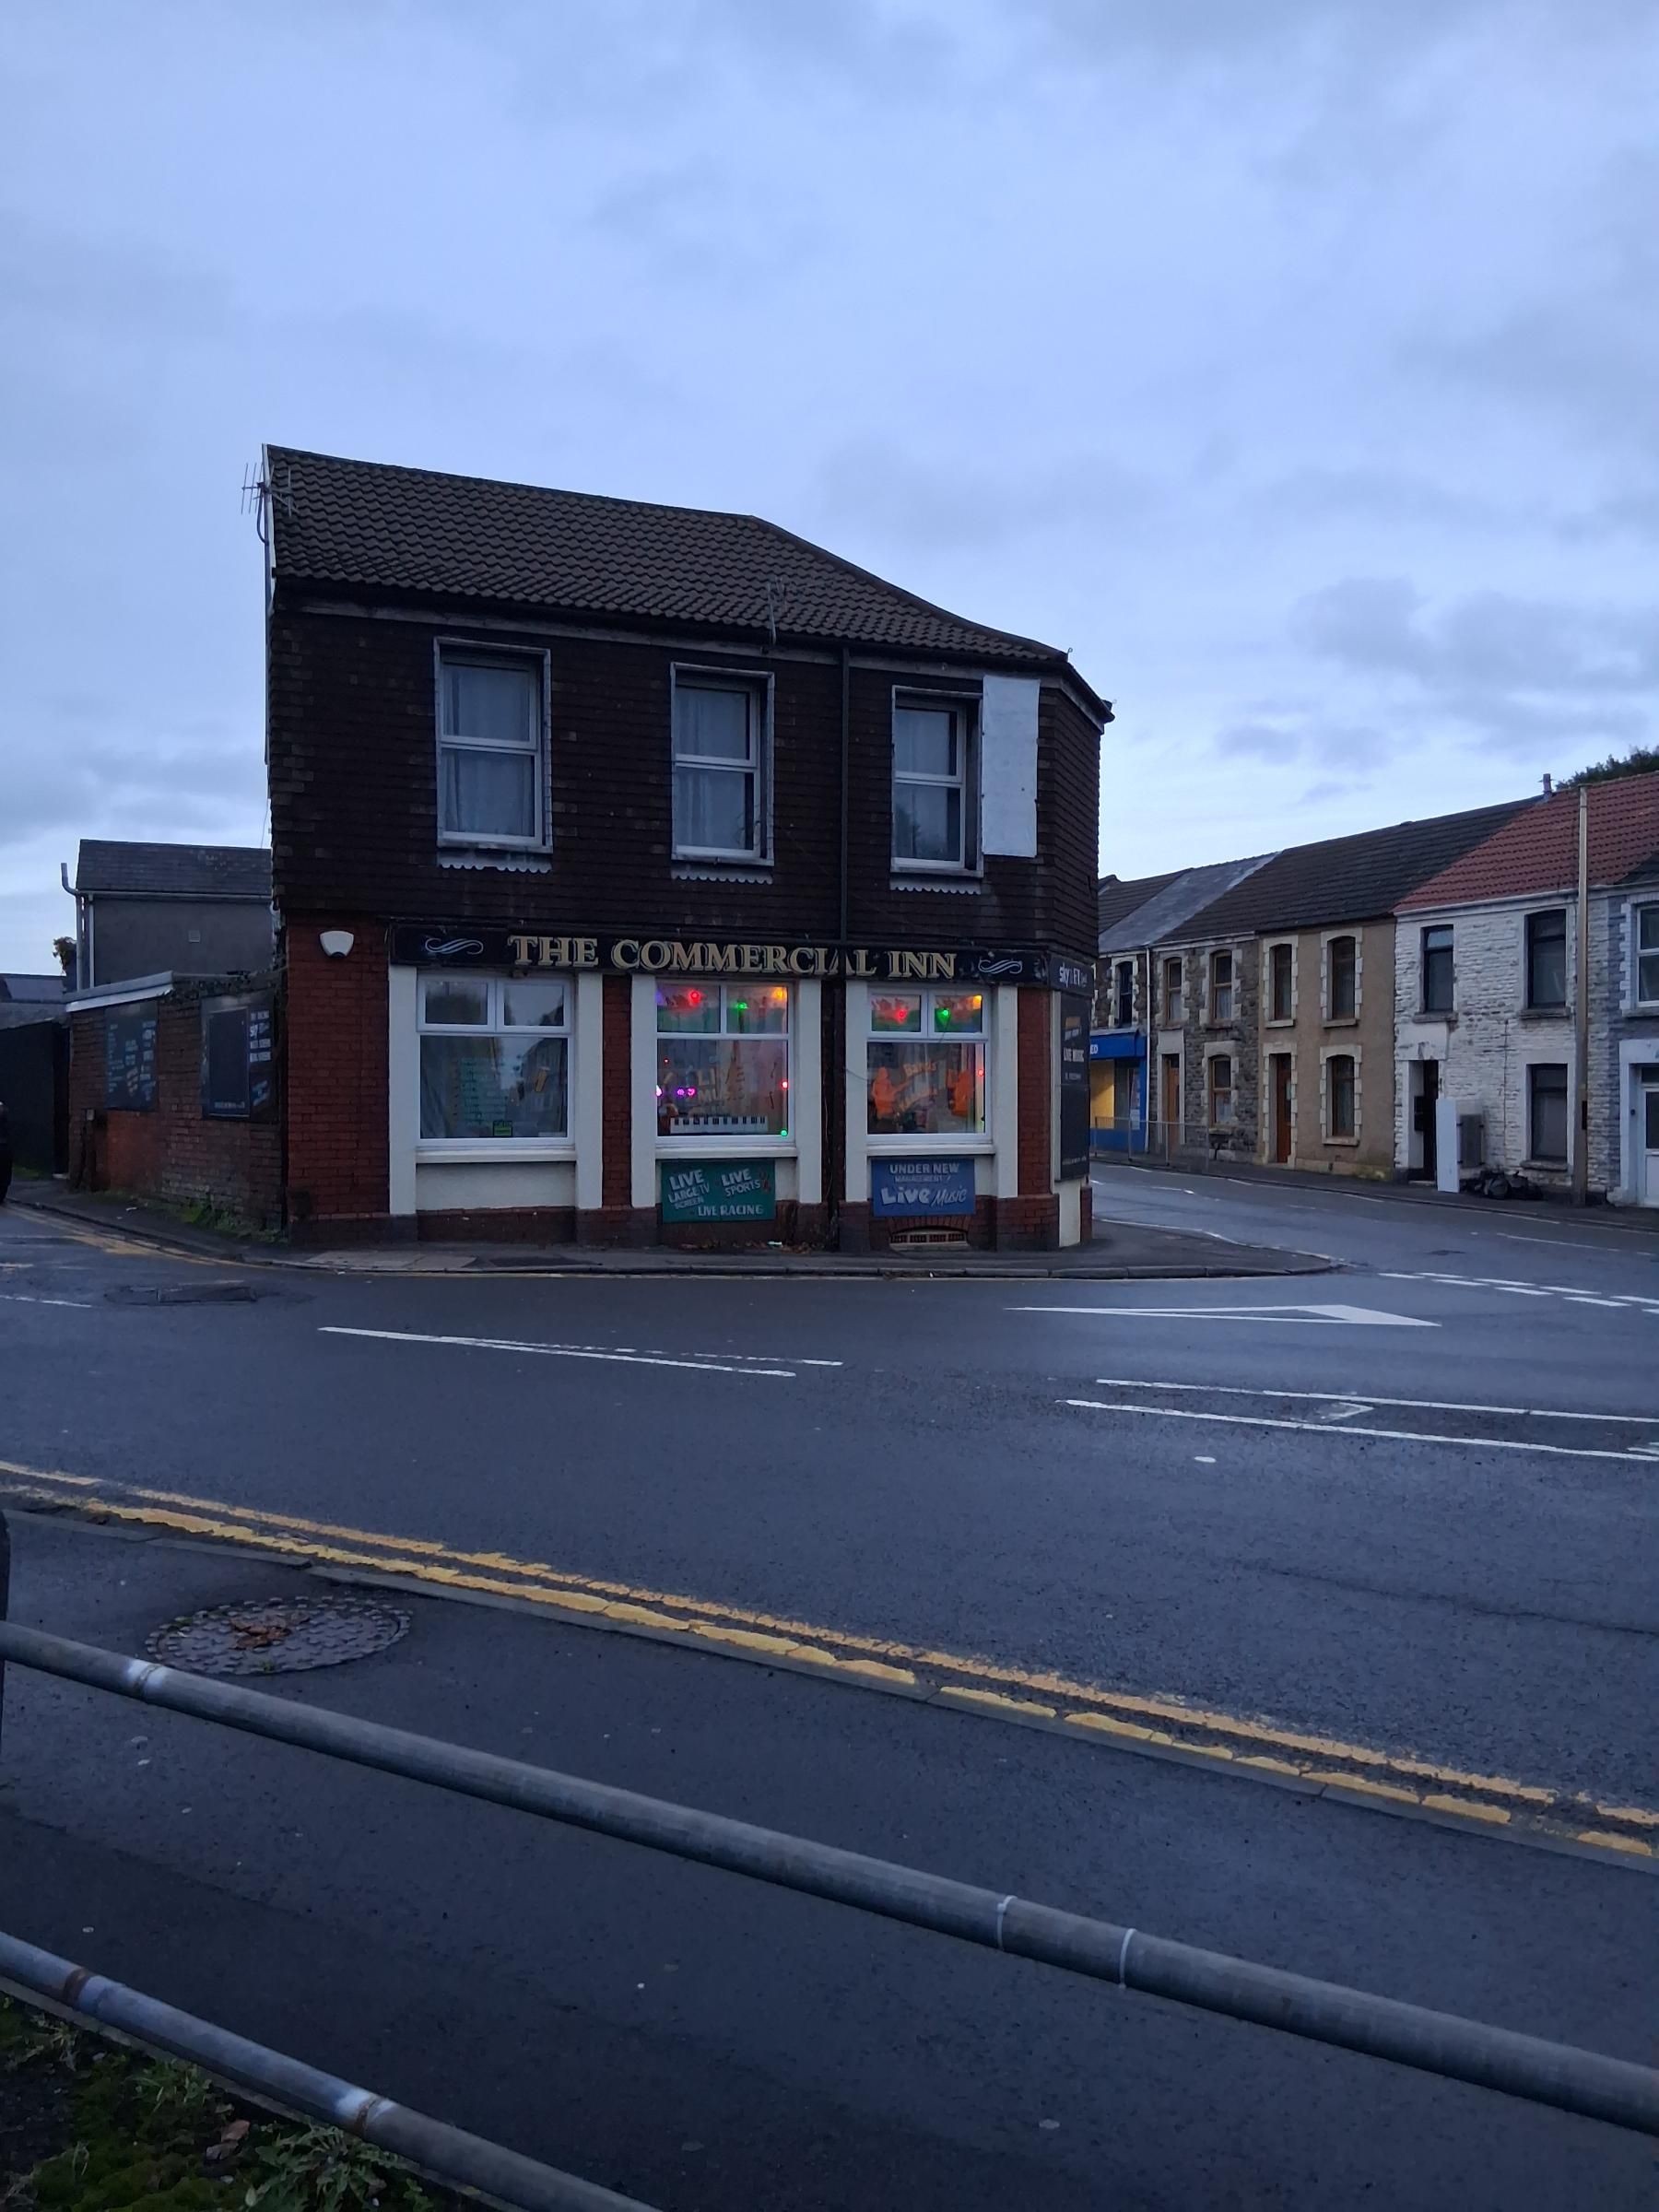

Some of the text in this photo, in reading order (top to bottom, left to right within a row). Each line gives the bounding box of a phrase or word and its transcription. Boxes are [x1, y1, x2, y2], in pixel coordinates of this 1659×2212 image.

[507, 935, 958, 980] THE COMMERCIAL INN
[720, 1168, 752, 1187] LIVE
[889, 1162, 959, 1175] UNDER NEW
[668, 1169, 705, 1191] LIVE
[724, 1179, 761, 1197] SPORTS
[668, 1182, 711, 1204] LARGE TV
[697, 1204, 764, 1217] LIVE RACING
